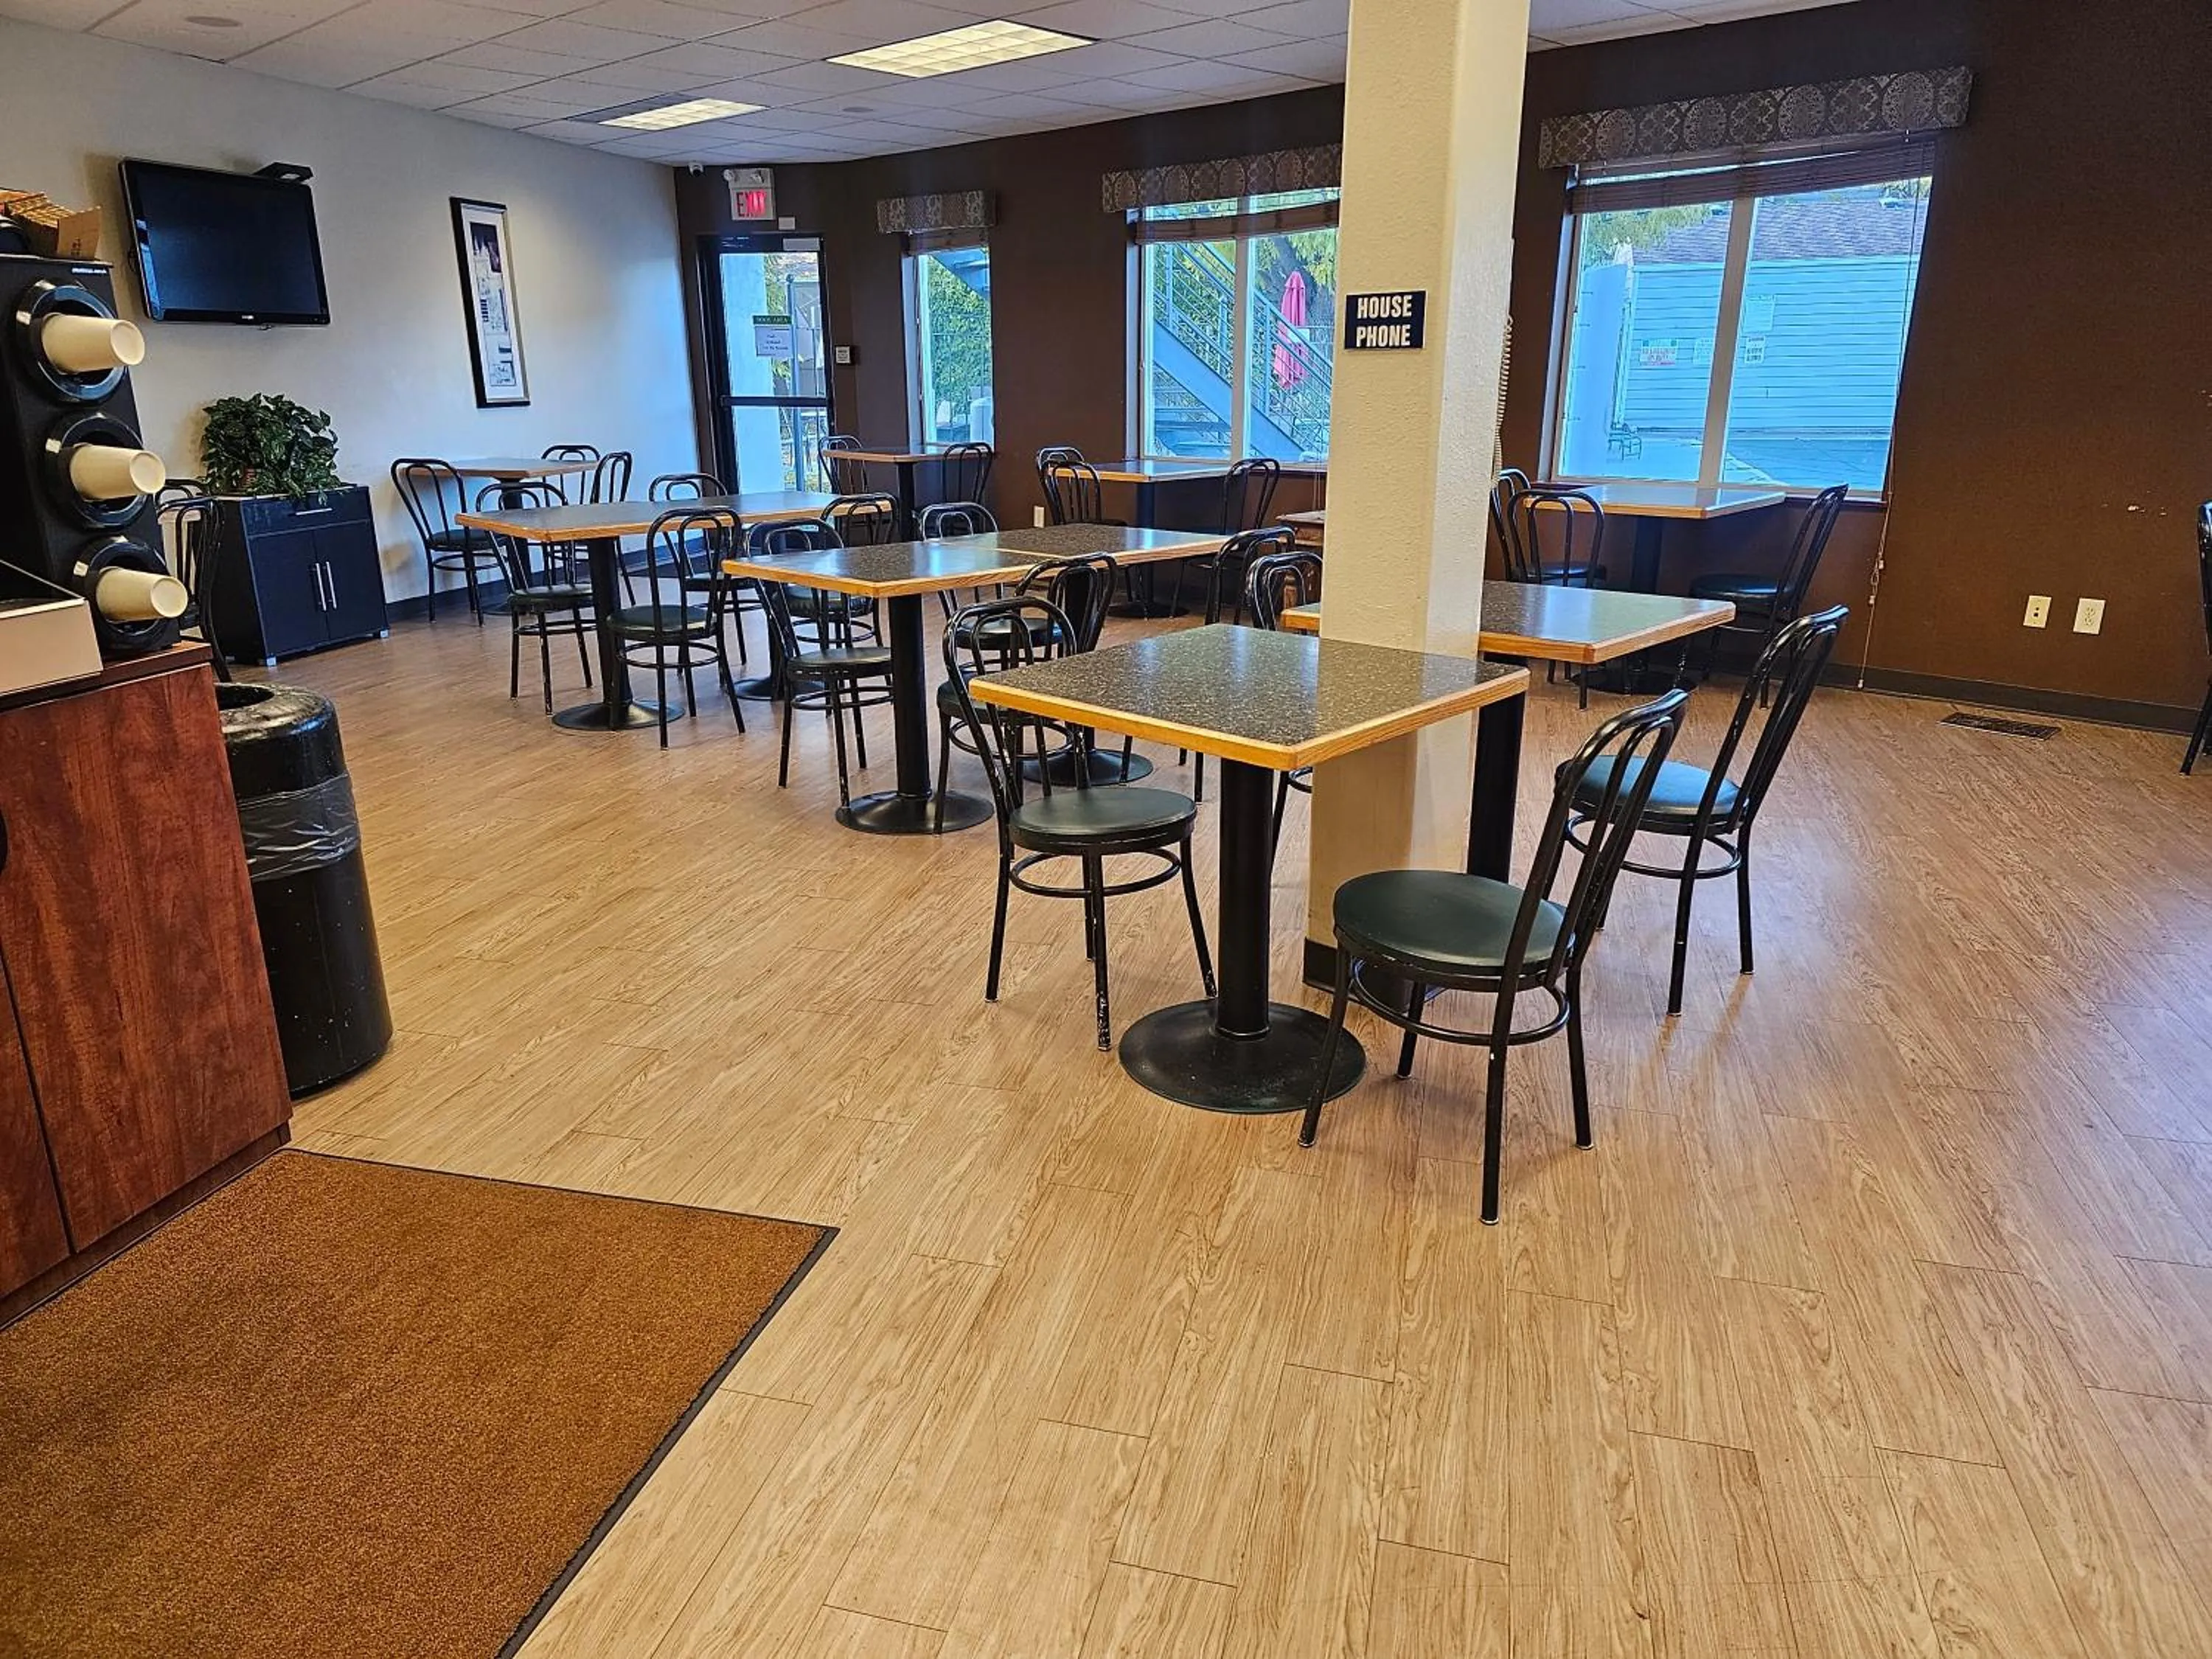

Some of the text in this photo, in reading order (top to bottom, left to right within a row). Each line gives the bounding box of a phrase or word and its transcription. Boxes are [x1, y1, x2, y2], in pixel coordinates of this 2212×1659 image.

[737, 192, 767, 217] EXIT
[1357, 295, 1413, 319] HOUSE
[1356, 324, 1411, 347] PHONE
